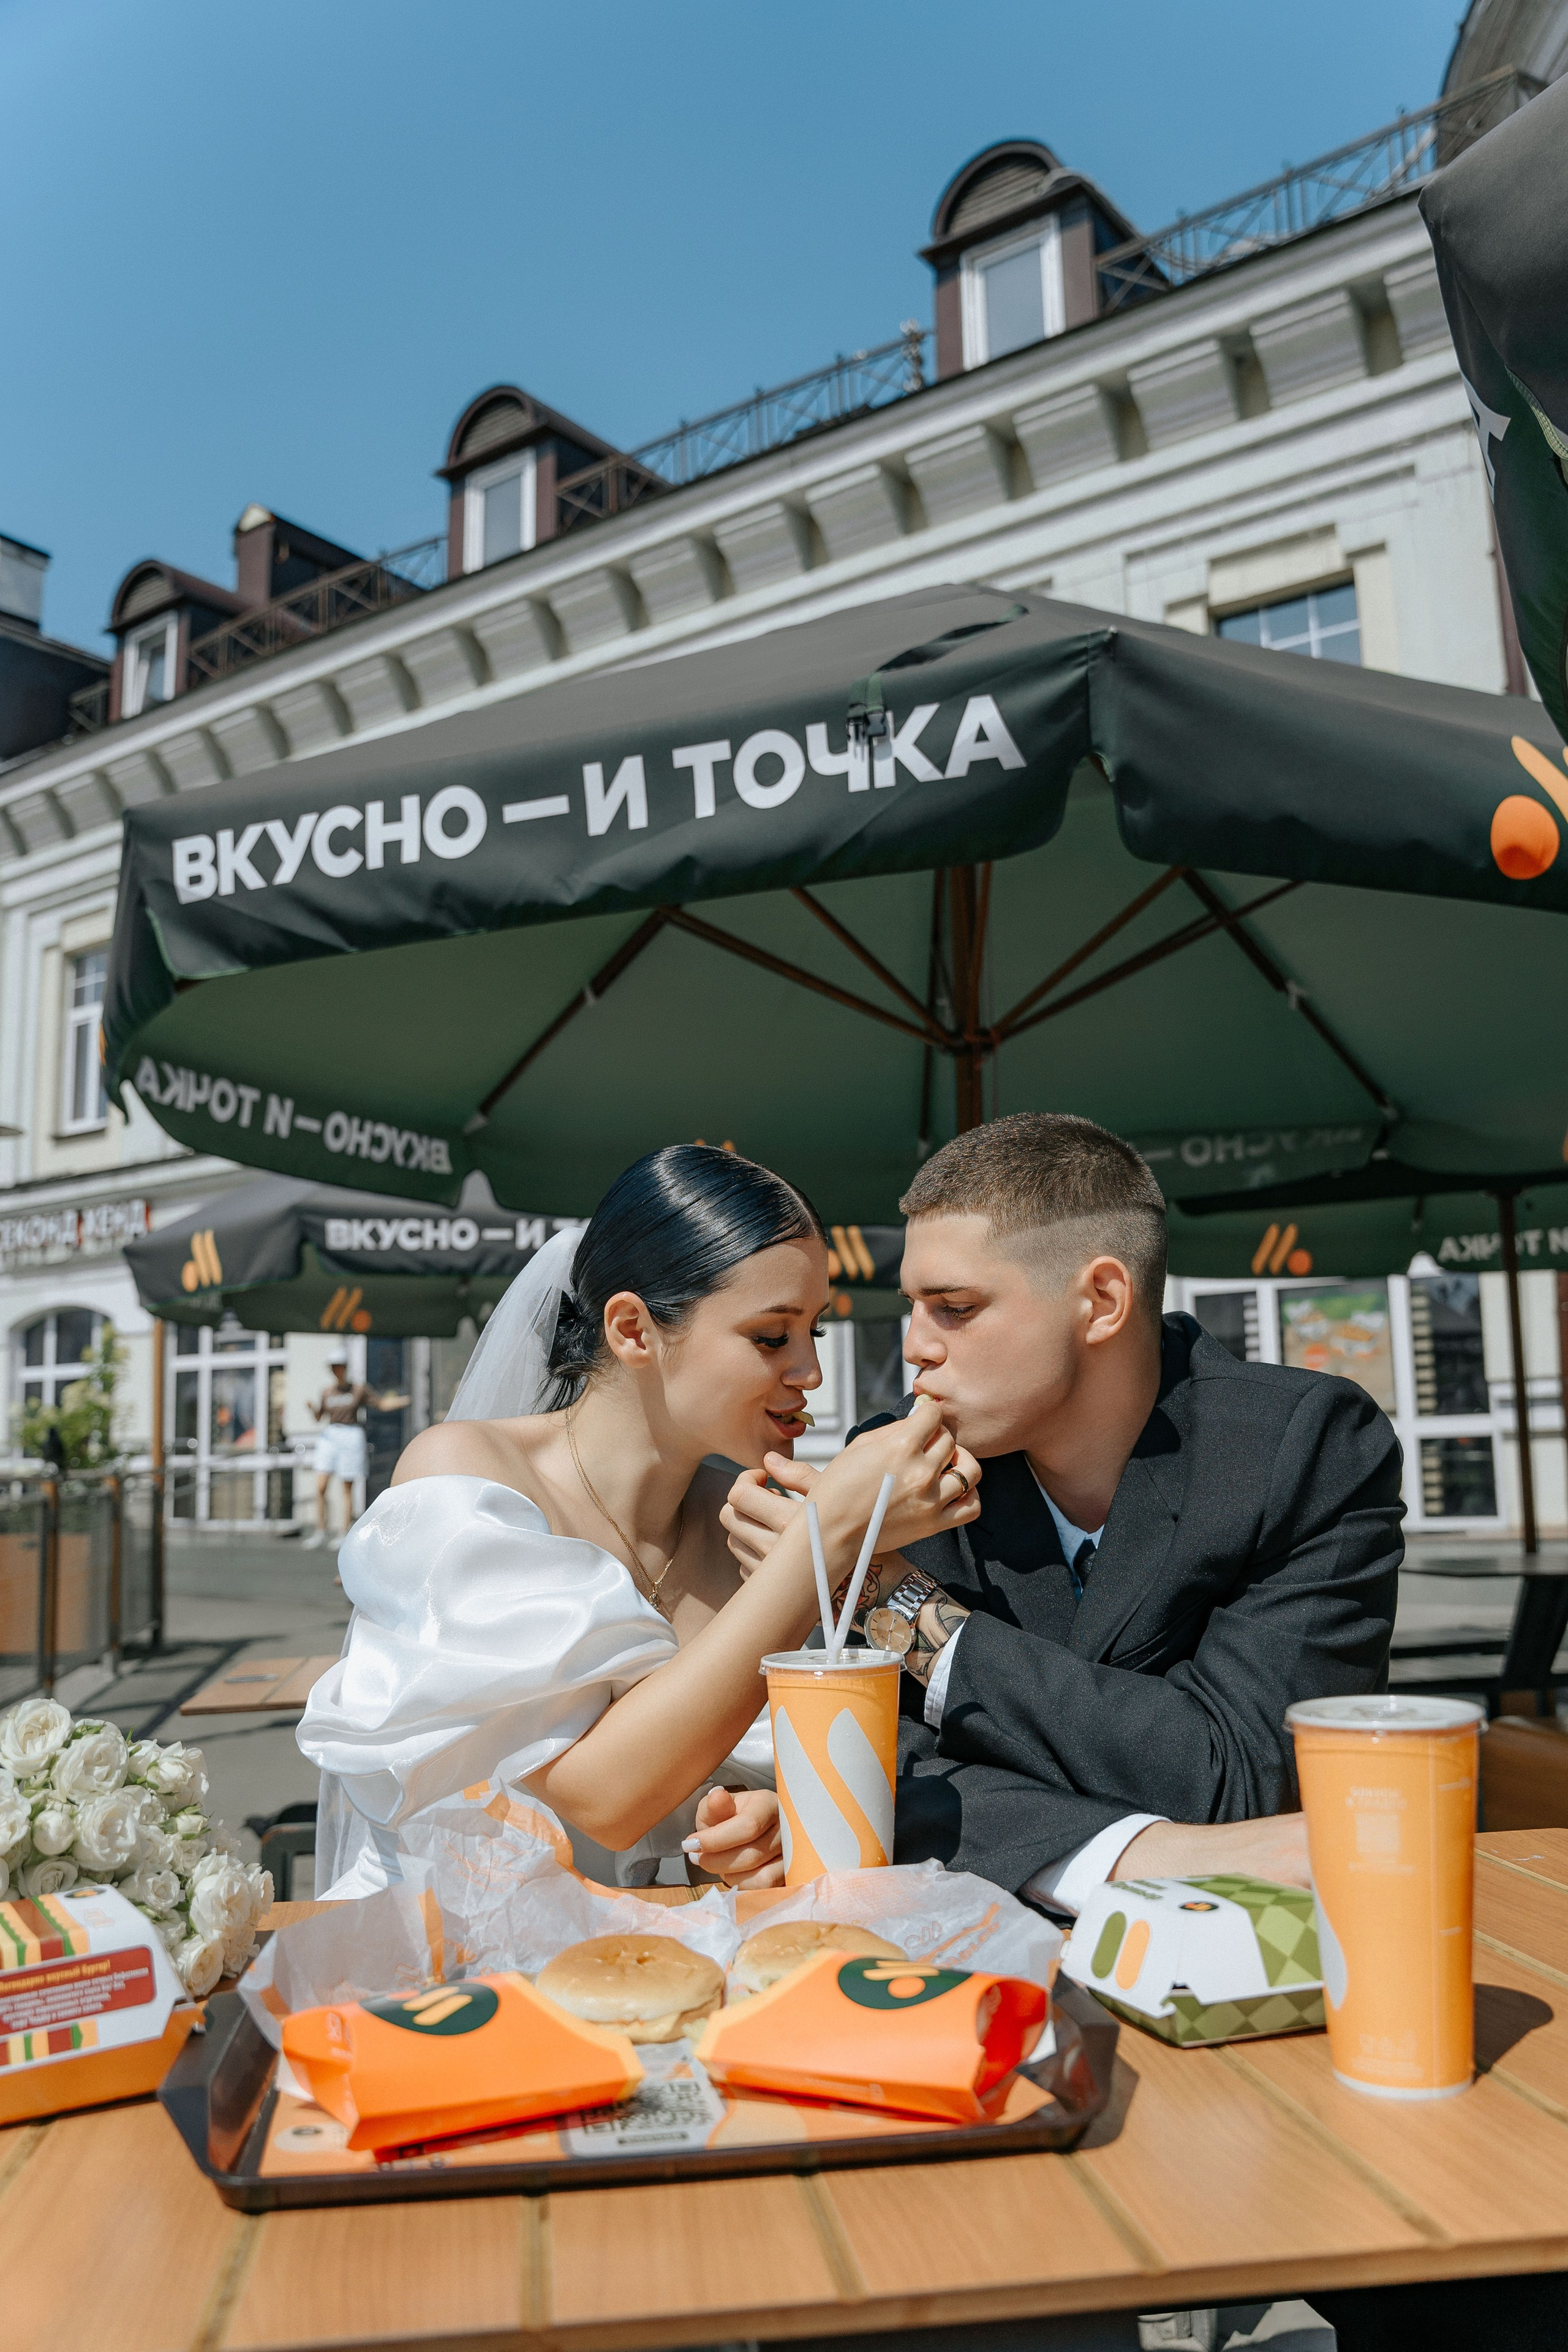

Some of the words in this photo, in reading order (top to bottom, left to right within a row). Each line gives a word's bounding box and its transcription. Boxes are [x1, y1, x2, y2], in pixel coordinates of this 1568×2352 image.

[172, 785, 488, 905] ВКУСНО
[582, 754, 648, 836] И
[671, 694, 1027, 820] ТОЧКА
[325, 1217, 480, 1251] ВКУСНО
[515, 1218, 546, 1251] И
